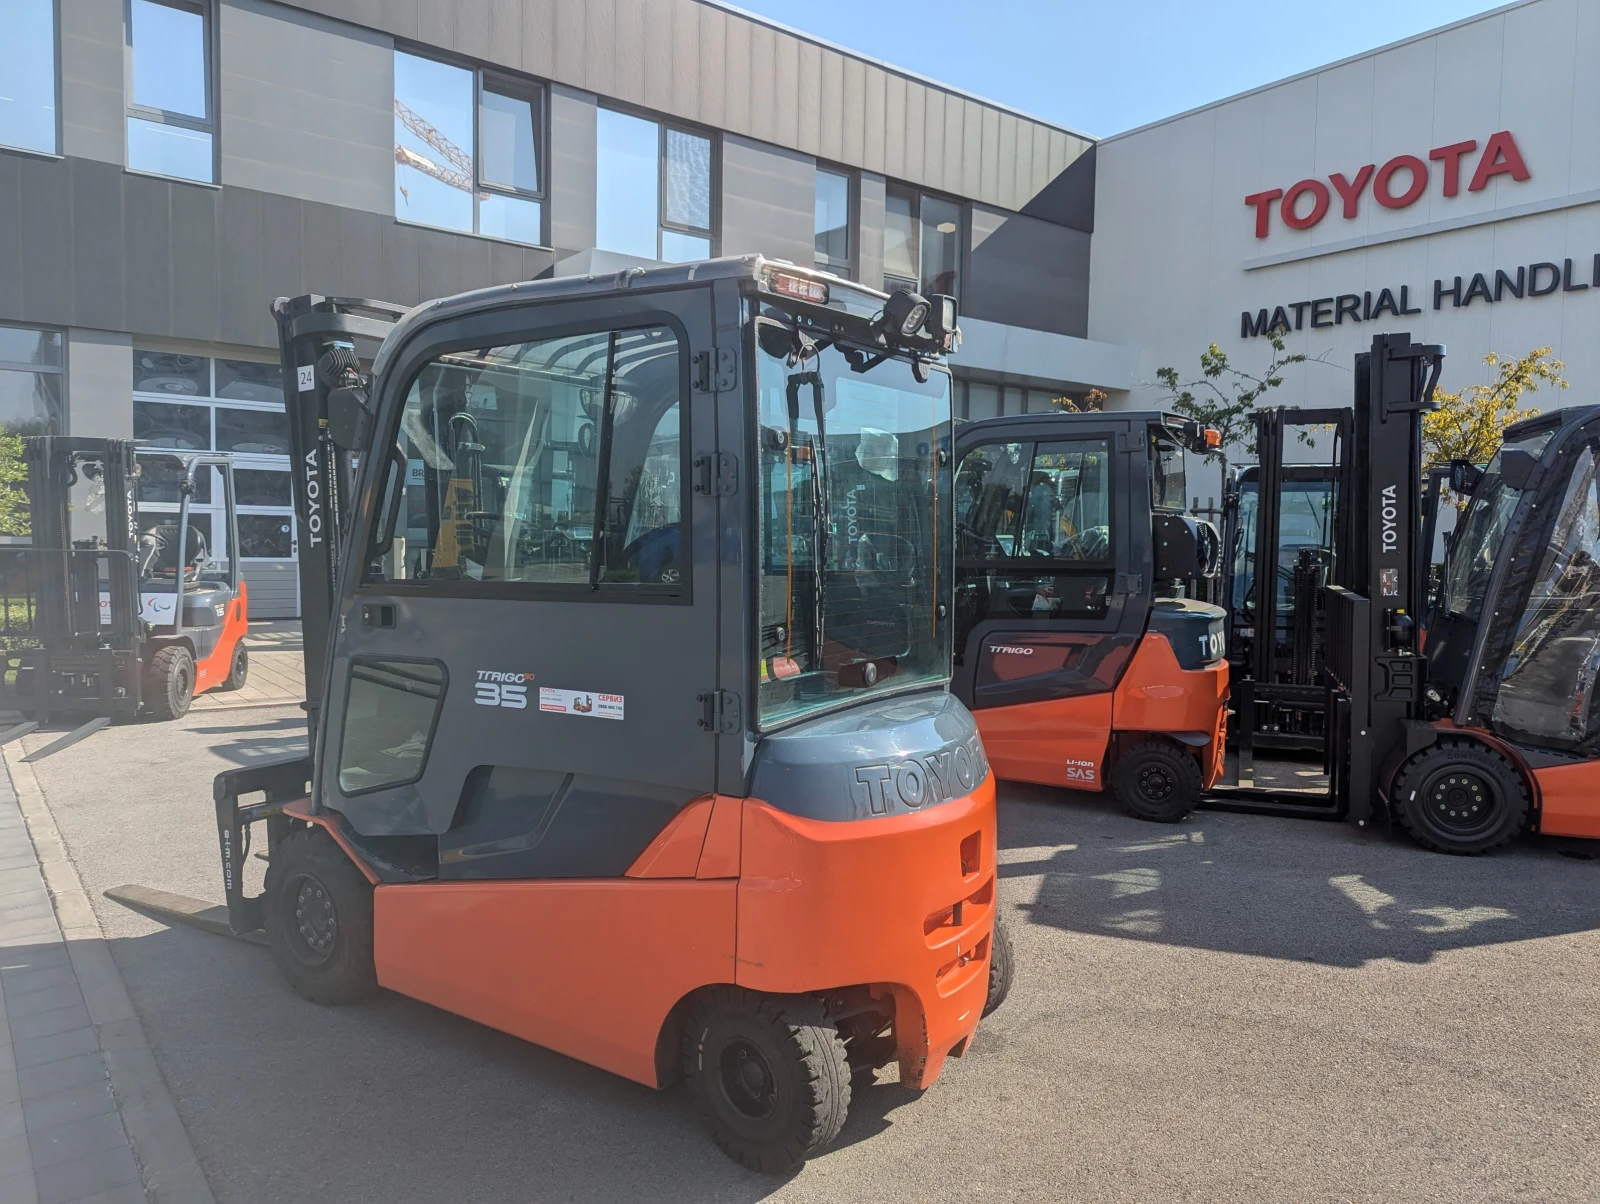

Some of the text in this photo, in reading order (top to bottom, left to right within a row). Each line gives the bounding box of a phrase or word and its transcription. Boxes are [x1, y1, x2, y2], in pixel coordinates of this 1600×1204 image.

[1244, 130, 1531, 239] TOYOTA
[1240, 284, 1422, 339] MATERIAL
[300, 370, 313, 385] 24
[126, 489, 135, 540] TOYOTA
[305, 448, 322, 548] TOYOTA
[1381, 484, 1398, 554] TOYOTA
[474, 681, 528, 710] 35
[598, 694, 623, 703] СЕРВИЗ
[1066, 767, 1095, 780] SAS
